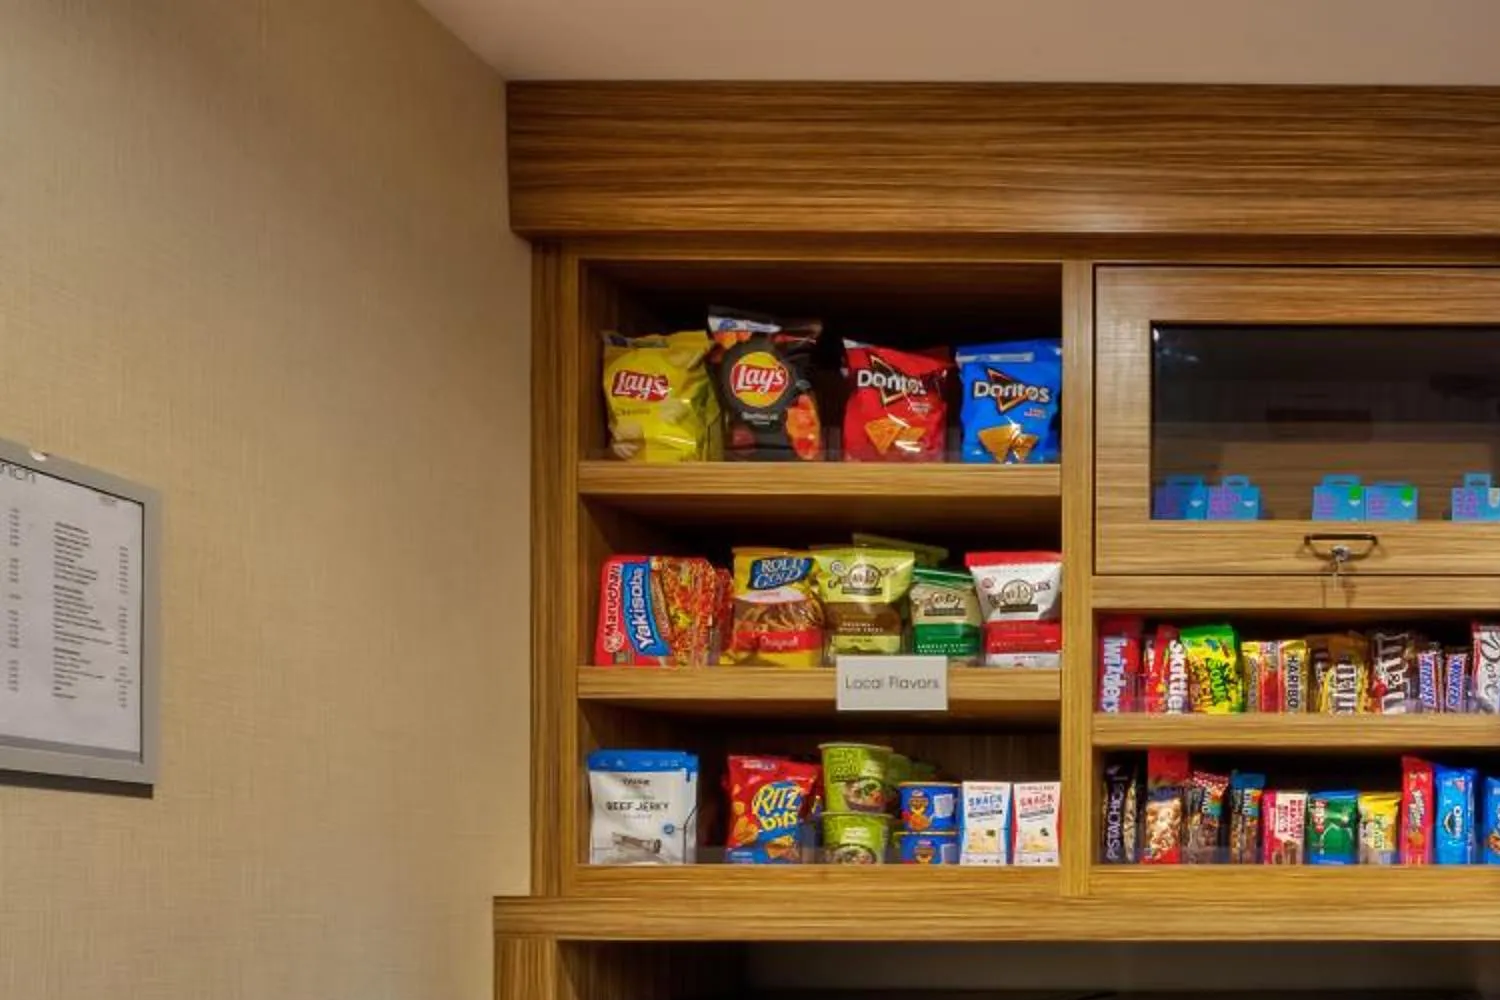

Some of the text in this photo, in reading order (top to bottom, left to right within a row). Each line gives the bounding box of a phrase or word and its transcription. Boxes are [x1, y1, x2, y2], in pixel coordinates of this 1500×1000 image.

[615, 371, 667, 398] Lay's
[736, 364, 785, 392] Lay's
[974, 381, 1050, 402] Doritos
[630, 567, 656, 649] Yakisoba
[845, 676, 940, 690] Local Flavors
[1287, 655, 1299, 708] HARIBO
